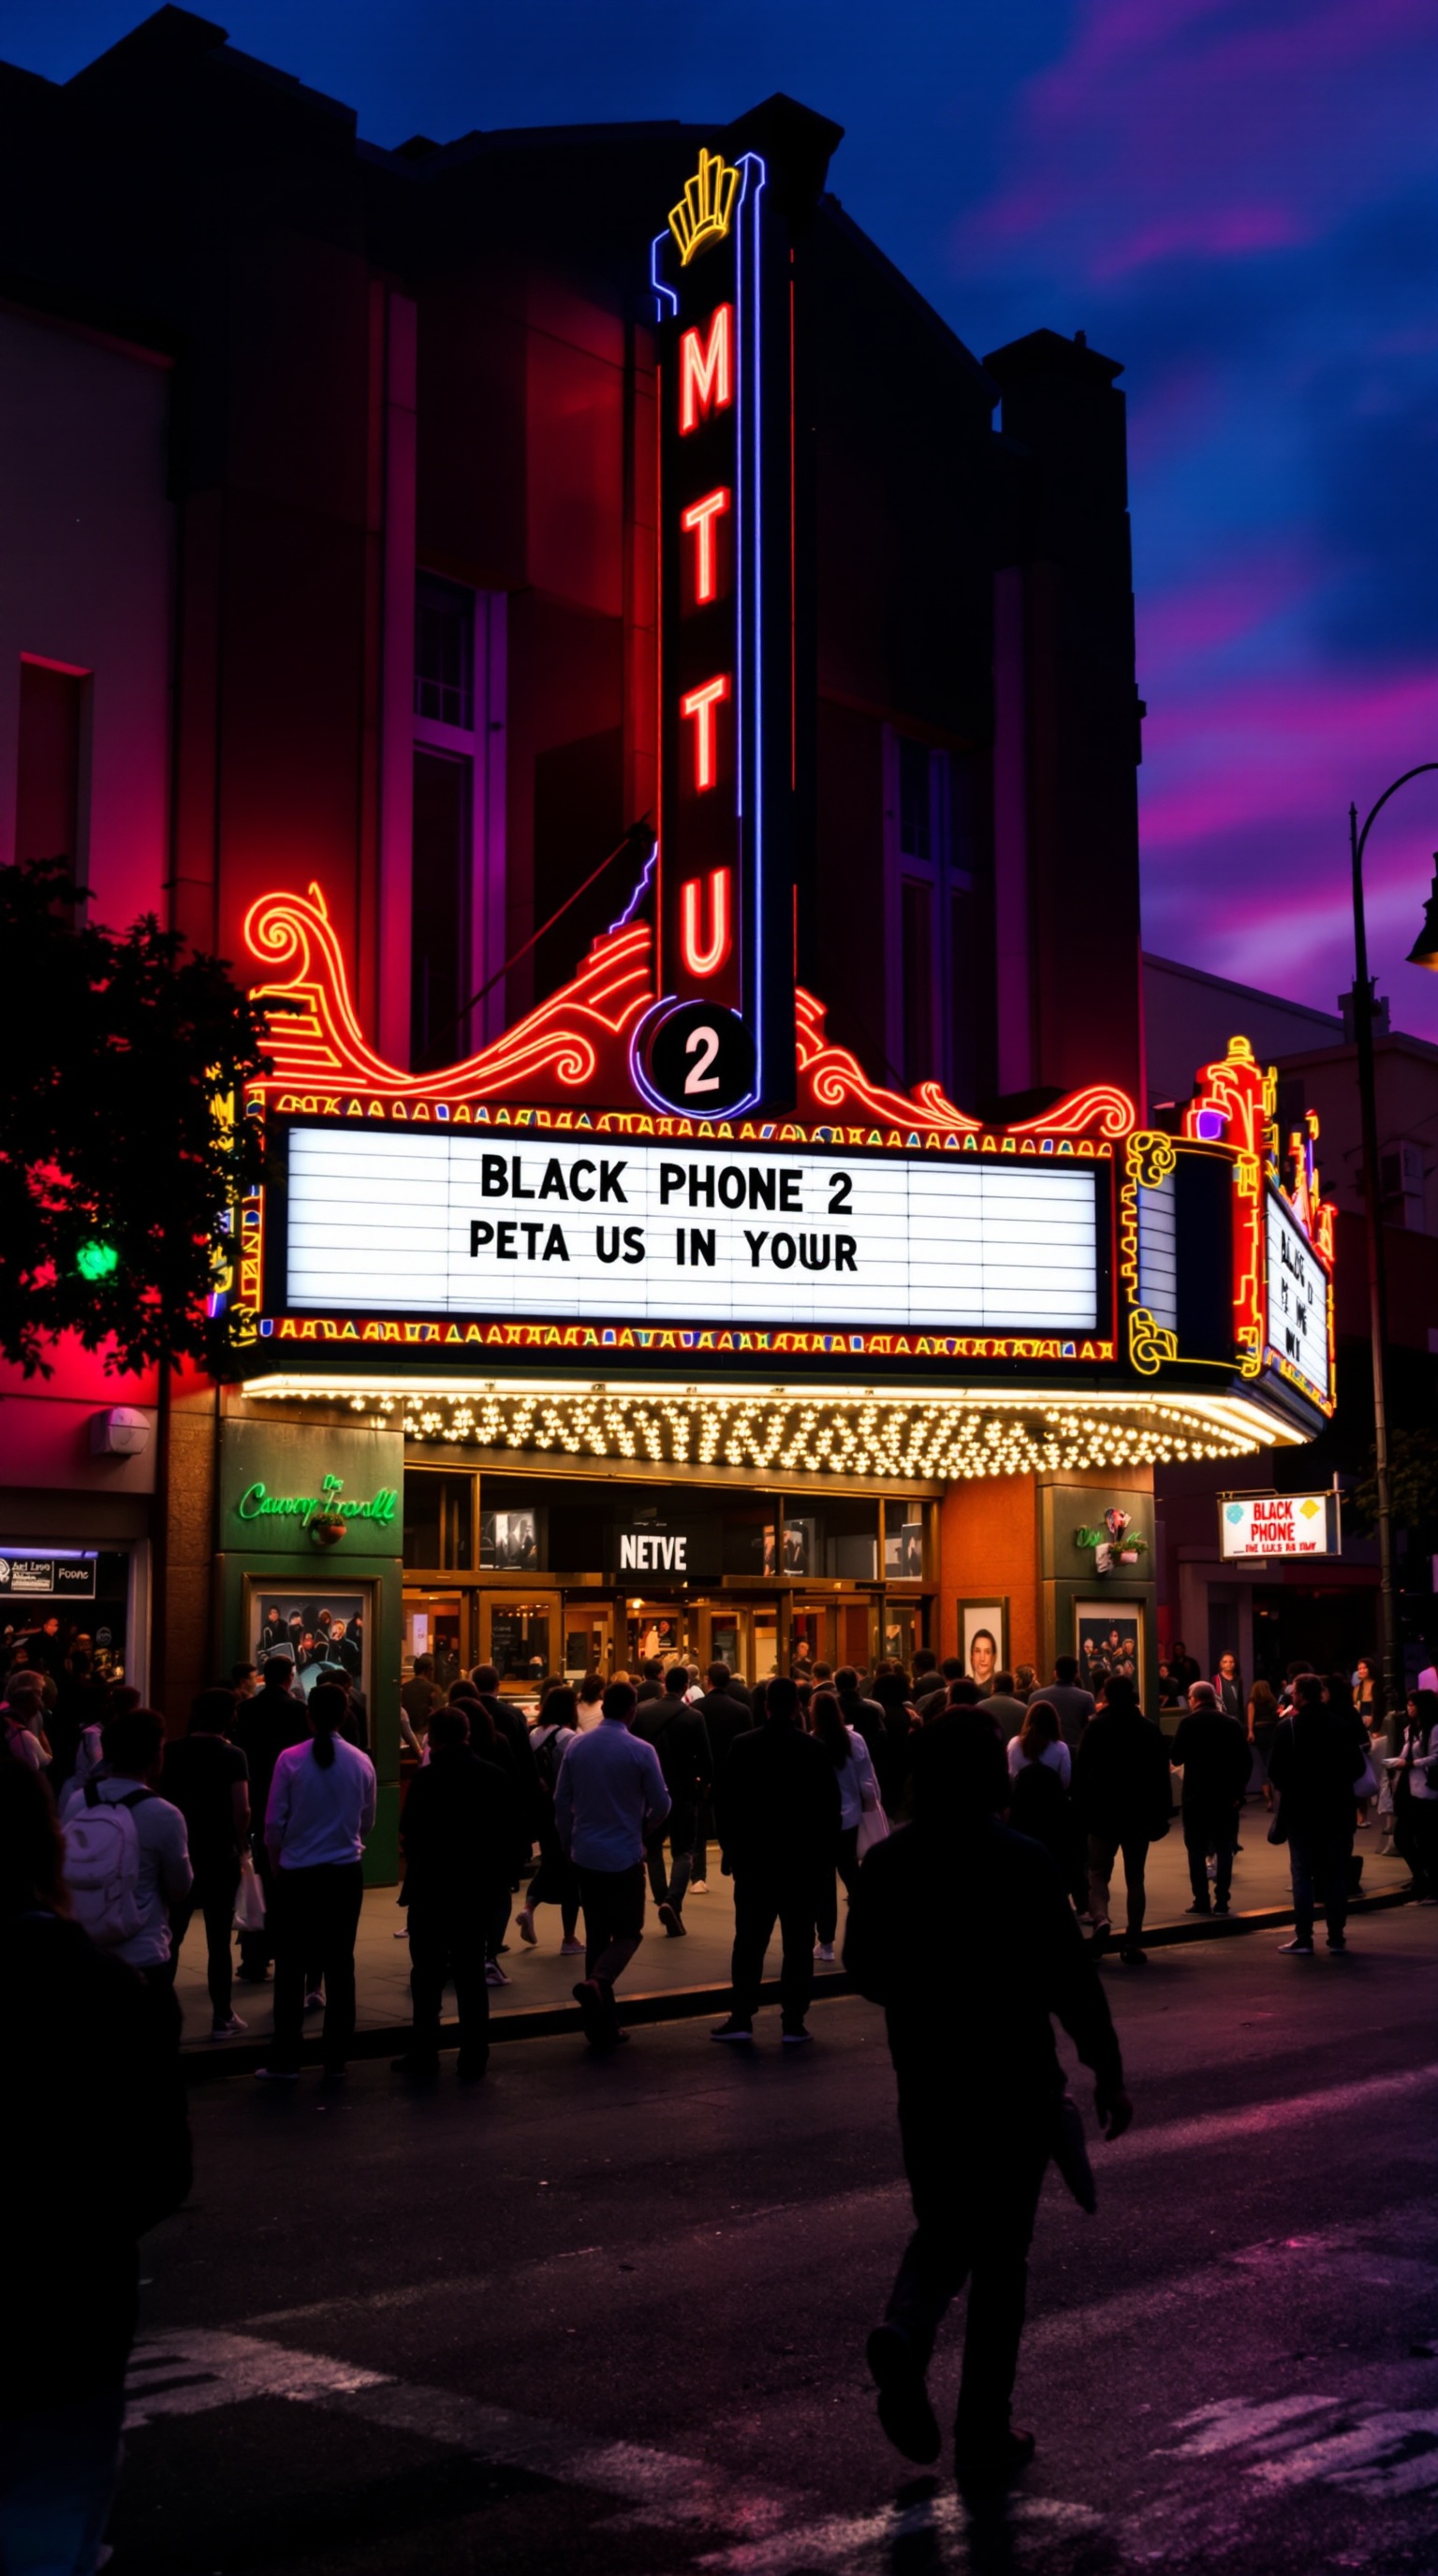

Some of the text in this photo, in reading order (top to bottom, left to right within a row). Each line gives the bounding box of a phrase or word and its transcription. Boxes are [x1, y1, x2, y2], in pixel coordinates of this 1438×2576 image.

[684, 1026, 721, 1095] 2
[481, 1153, 853, 1215] BLACK PHONE 2
[470, 1220, 858, 1272] PETA US IN YOUR
[1251, 1522, 1295, 1542] PHONE
[1254, 1500, 1293, 1521] BLACK
[620, 1534, 687, 1571] NETVE
